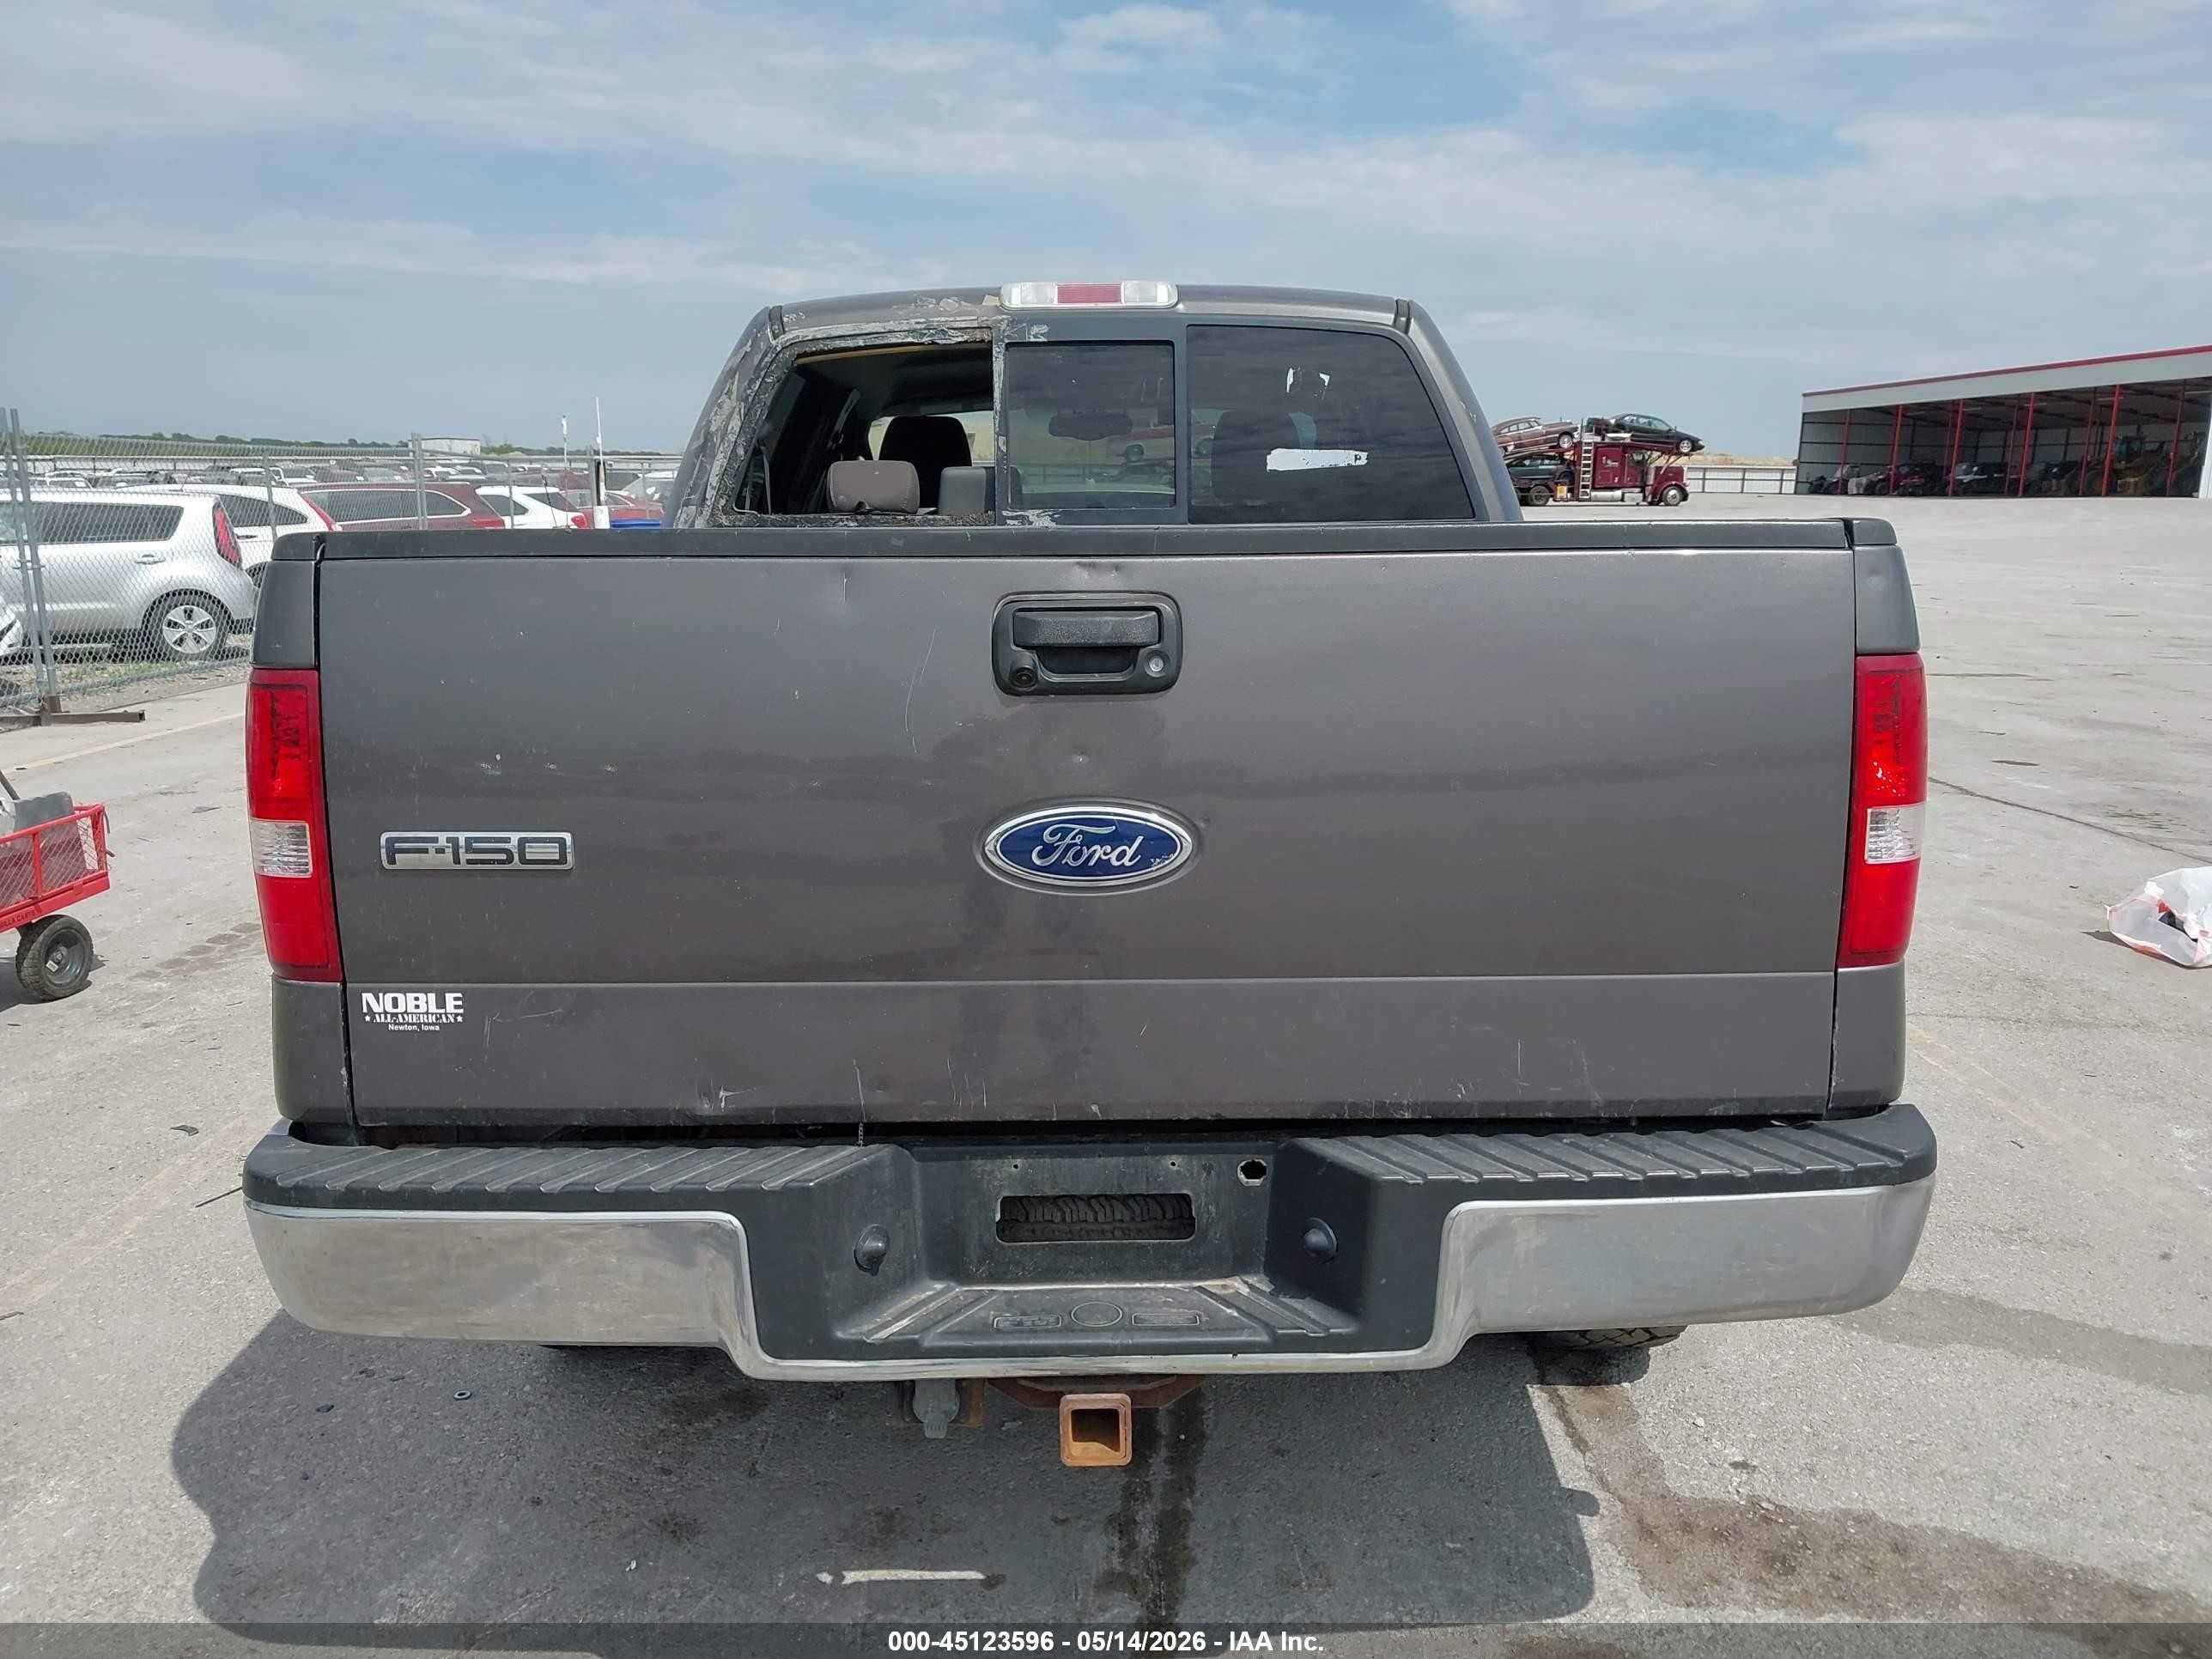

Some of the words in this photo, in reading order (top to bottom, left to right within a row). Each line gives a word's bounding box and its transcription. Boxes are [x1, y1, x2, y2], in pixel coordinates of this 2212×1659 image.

[386, 836, 568, 866] F-150
[1031, 823, 1144, 866] Ford
[361, 992, 465, 1014] NOBLE
[388, 1024, 420, 1032] Newton,
[421, 1023, 441, 1031] Iowa
